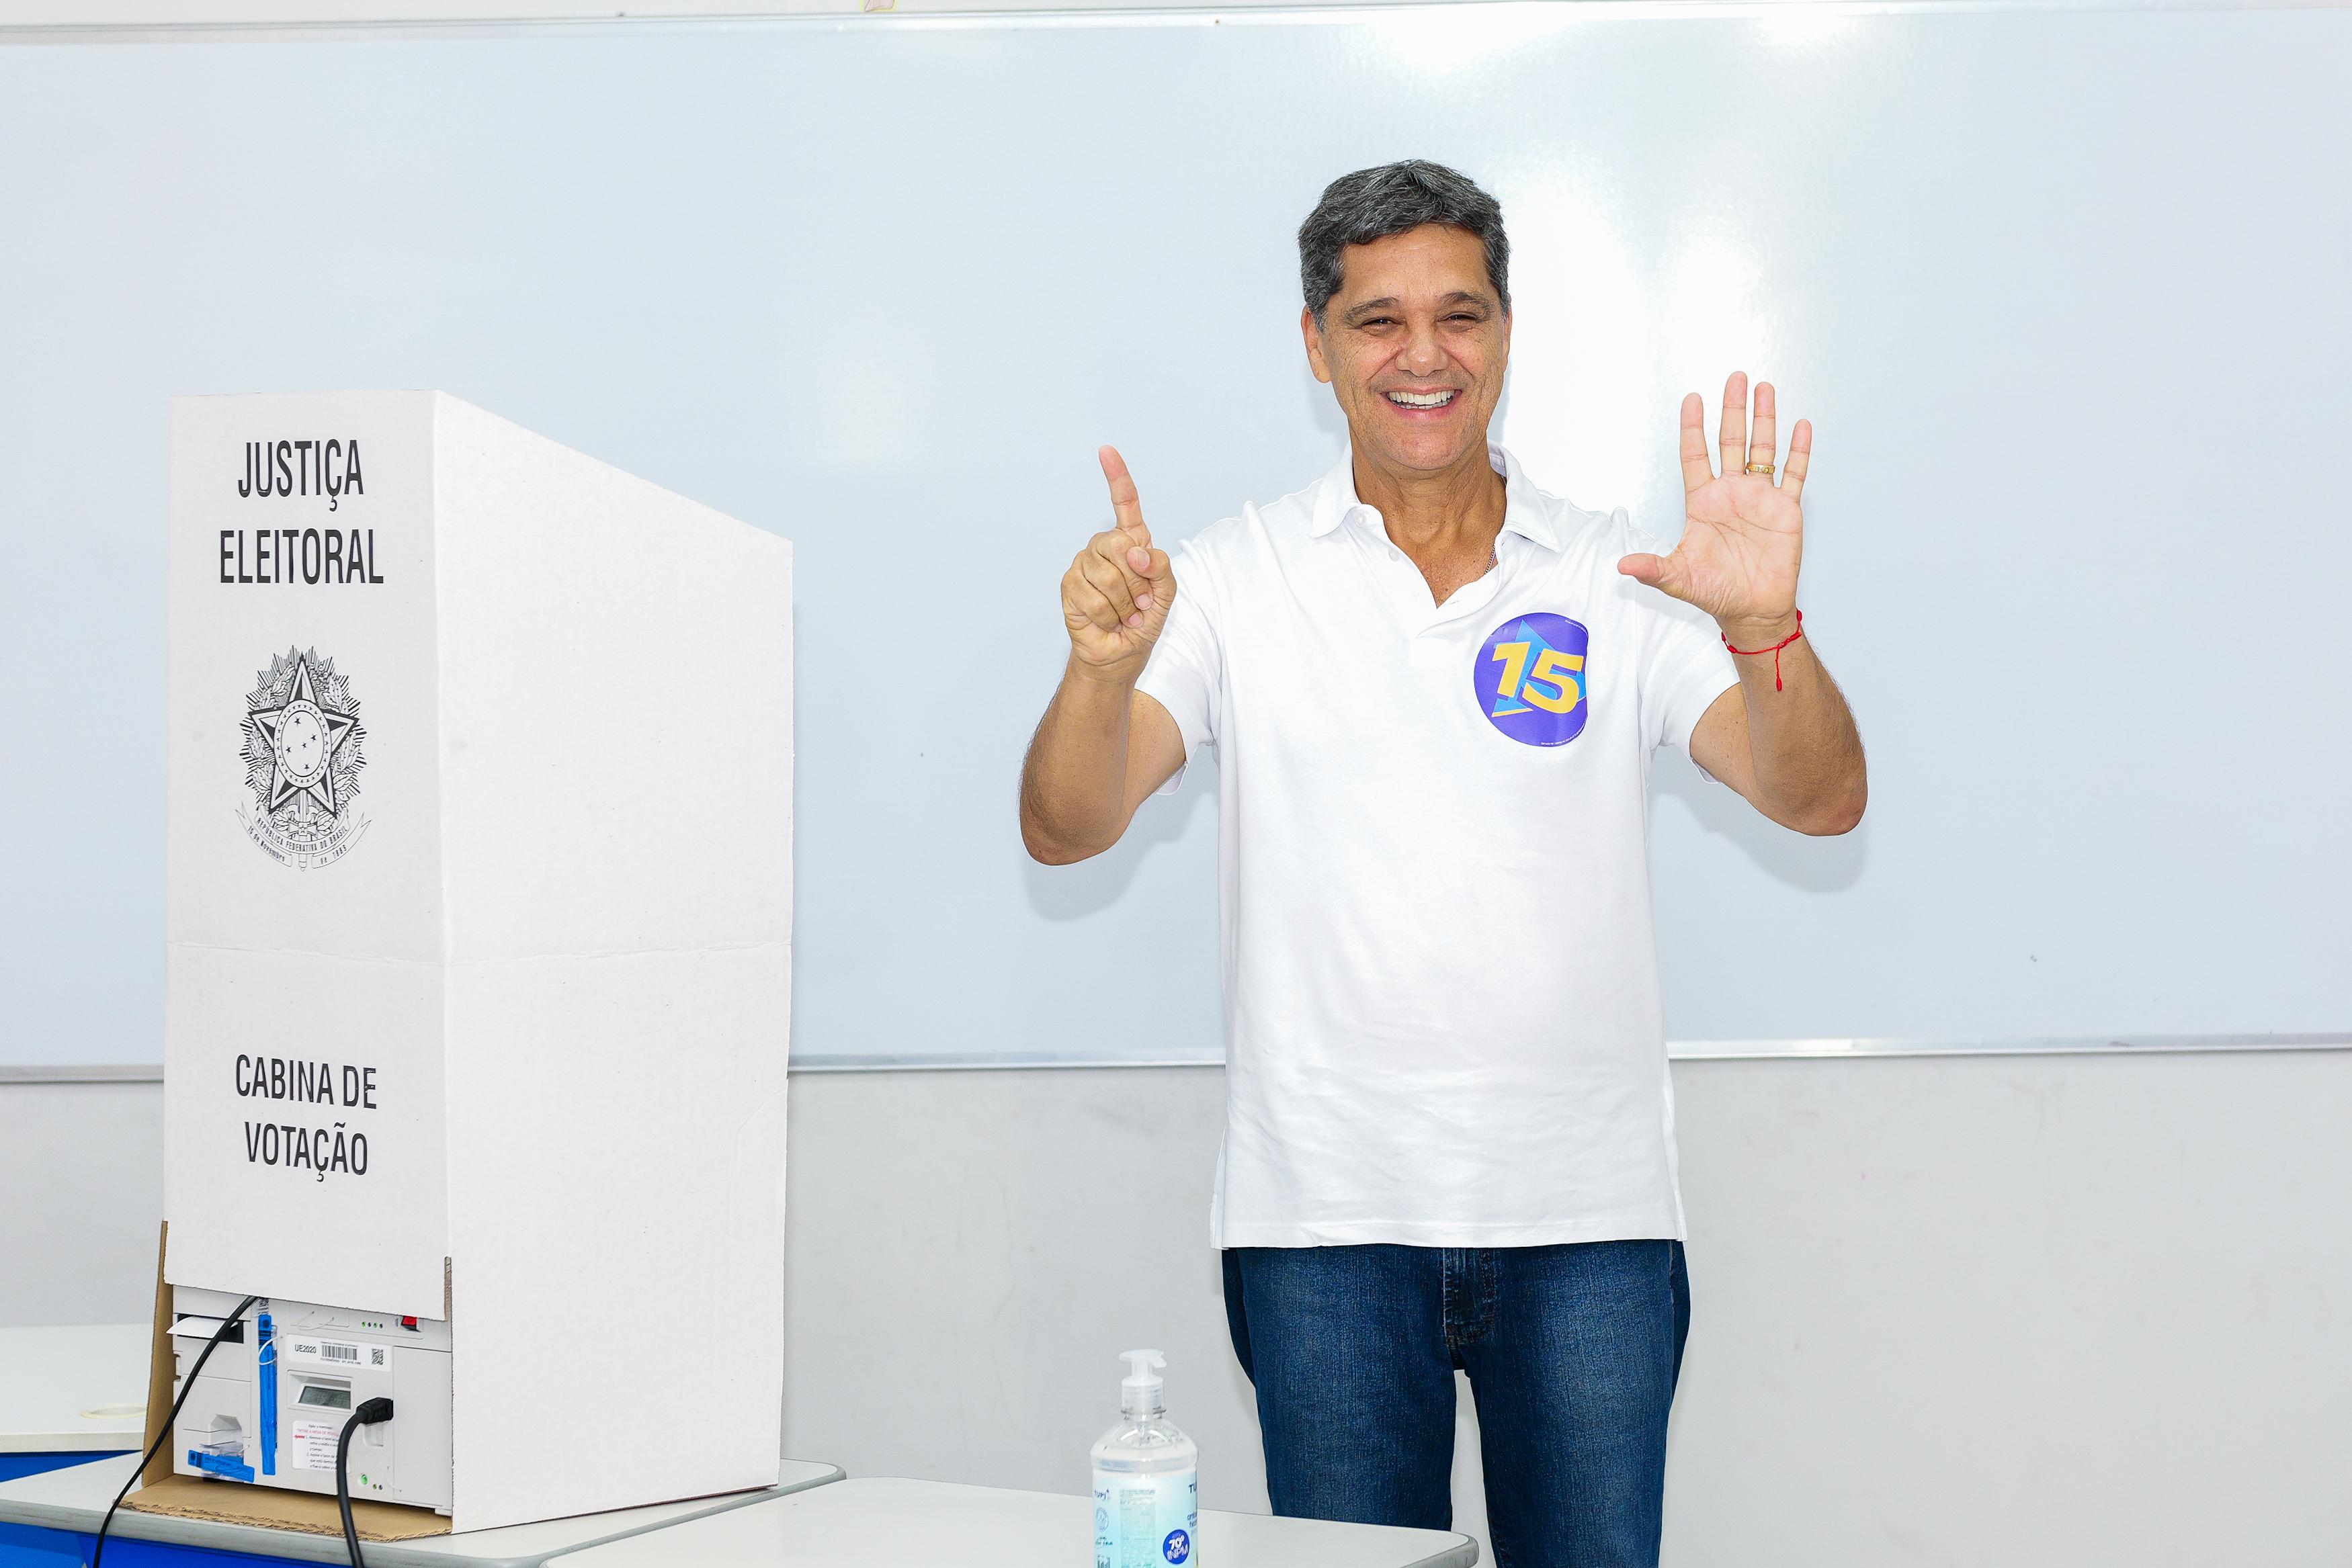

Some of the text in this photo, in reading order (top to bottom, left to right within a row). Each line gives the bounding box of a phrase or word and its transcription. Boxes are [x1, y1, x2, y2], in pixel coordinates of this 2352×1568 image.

[237, 439, 364, 512] JUSTIÇA
[220, 528, 384, 585] ELEITORAL
[1492, 641, 1585, 714] 15
[256, 818, 348, 852] REPÚBLICA FEDERATIVA DO BRASIL
[236, 1054, 377, 1110] CABINA DE
[244, 1121, 368, 1182] VOTAÇÃO
[294, 1344, 317, 1354] UE2020
